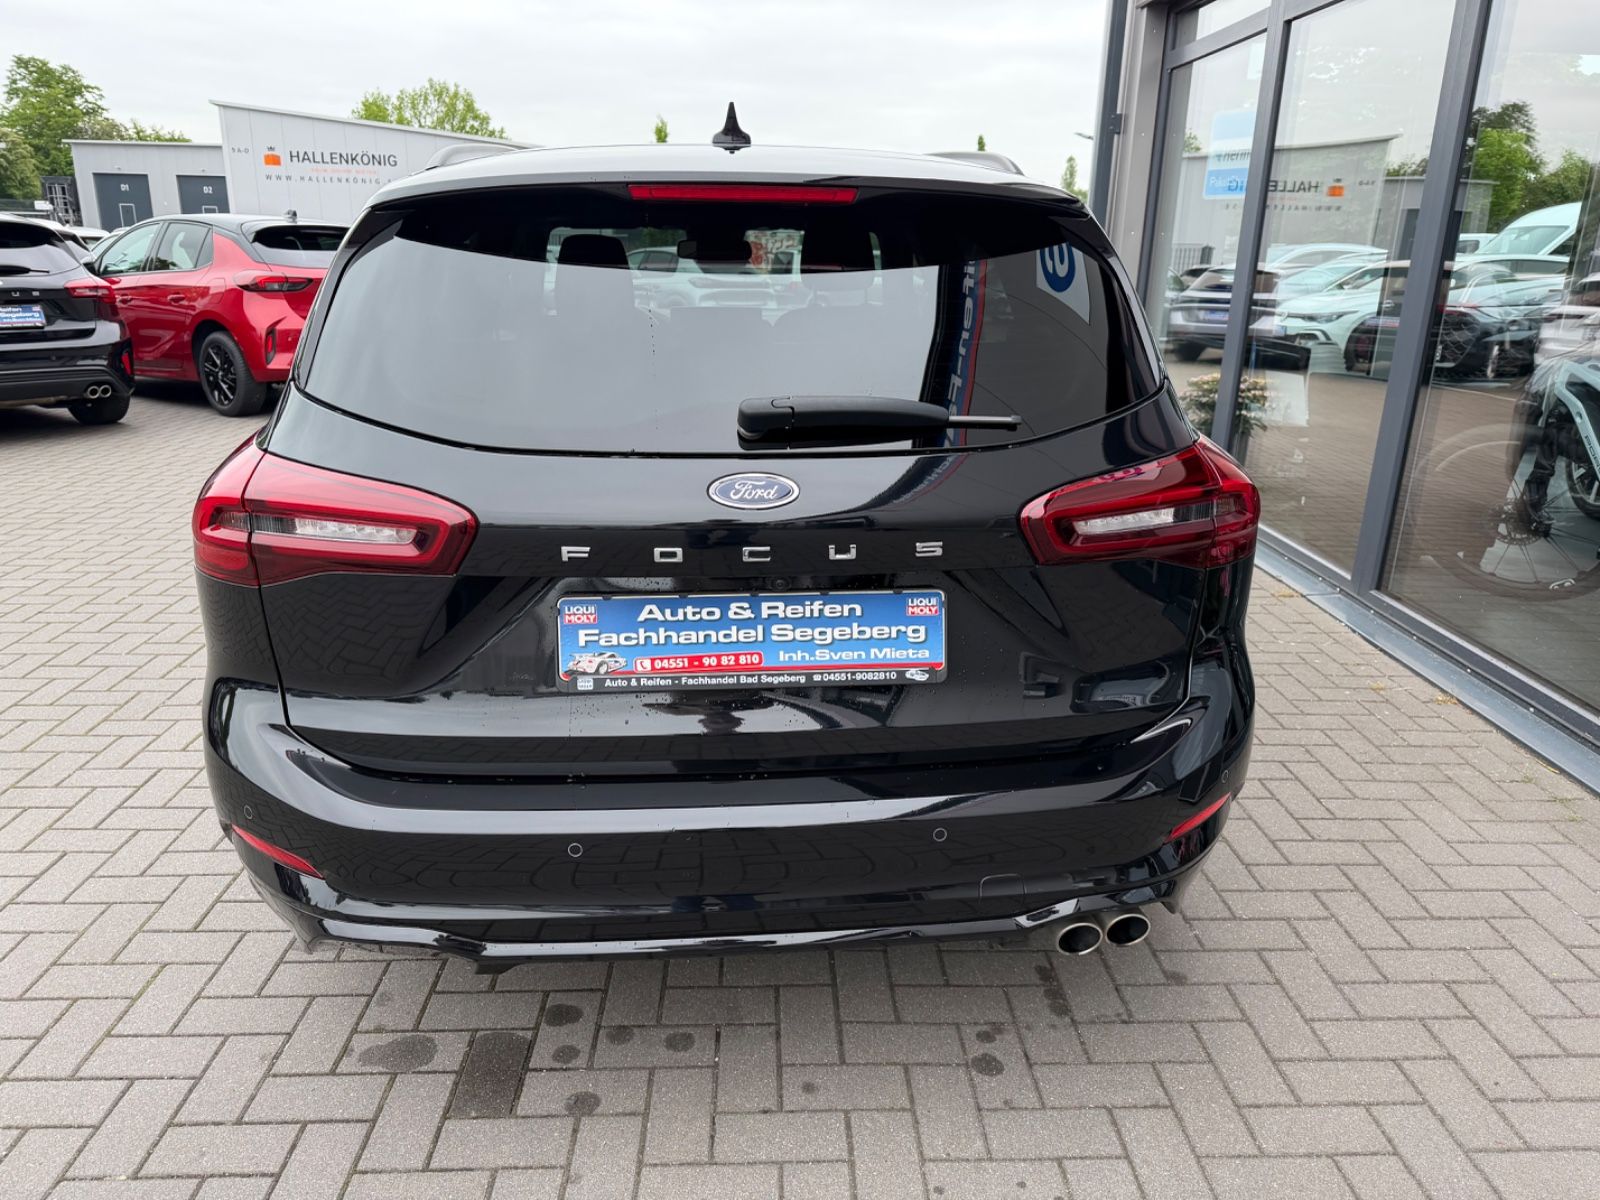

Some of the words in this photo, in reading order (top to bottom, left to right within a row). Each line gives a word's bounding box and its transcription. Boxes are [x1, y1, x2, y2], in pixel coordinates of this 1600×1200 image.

[289, 150, 398, 167] HALLENKÖNIG
[729, 480, 778, 501] Ford
[560, 541, 943, 563] FOCUS
[564, 605, 595, 614] LIQUI
[908, 598, 937, 606] LIQUI
[637, 604, 721, 622] Auto
[728, 602, 755, 620] &
[761, 600, 862, 619] Reifen
[907, 606, 937, 615] MOLY
[564, 614, 597, 624] MOLY
[578, 624, 764, 647] Fachhandel
[771, 622, 927, 645] Segeberg
[654, 658, 689, 670] 04551
[702, 656, 717, 667] 90
[721, 655, 735, 666] 82
[738, 654, 760, 665] 810
[870, 648, 930, 660] Mieta
[604, 678, 628, 688] Auto
[630, 677, 638, 687] &
[640, 676, 672, 687] Reifen
[681, 675, 737, 686] Fachhandel
[739, 675, 758, 685] Bad
[760, 674, 806, 684] Segeberg
[823, 671, 897, 682] 04551-9082810
